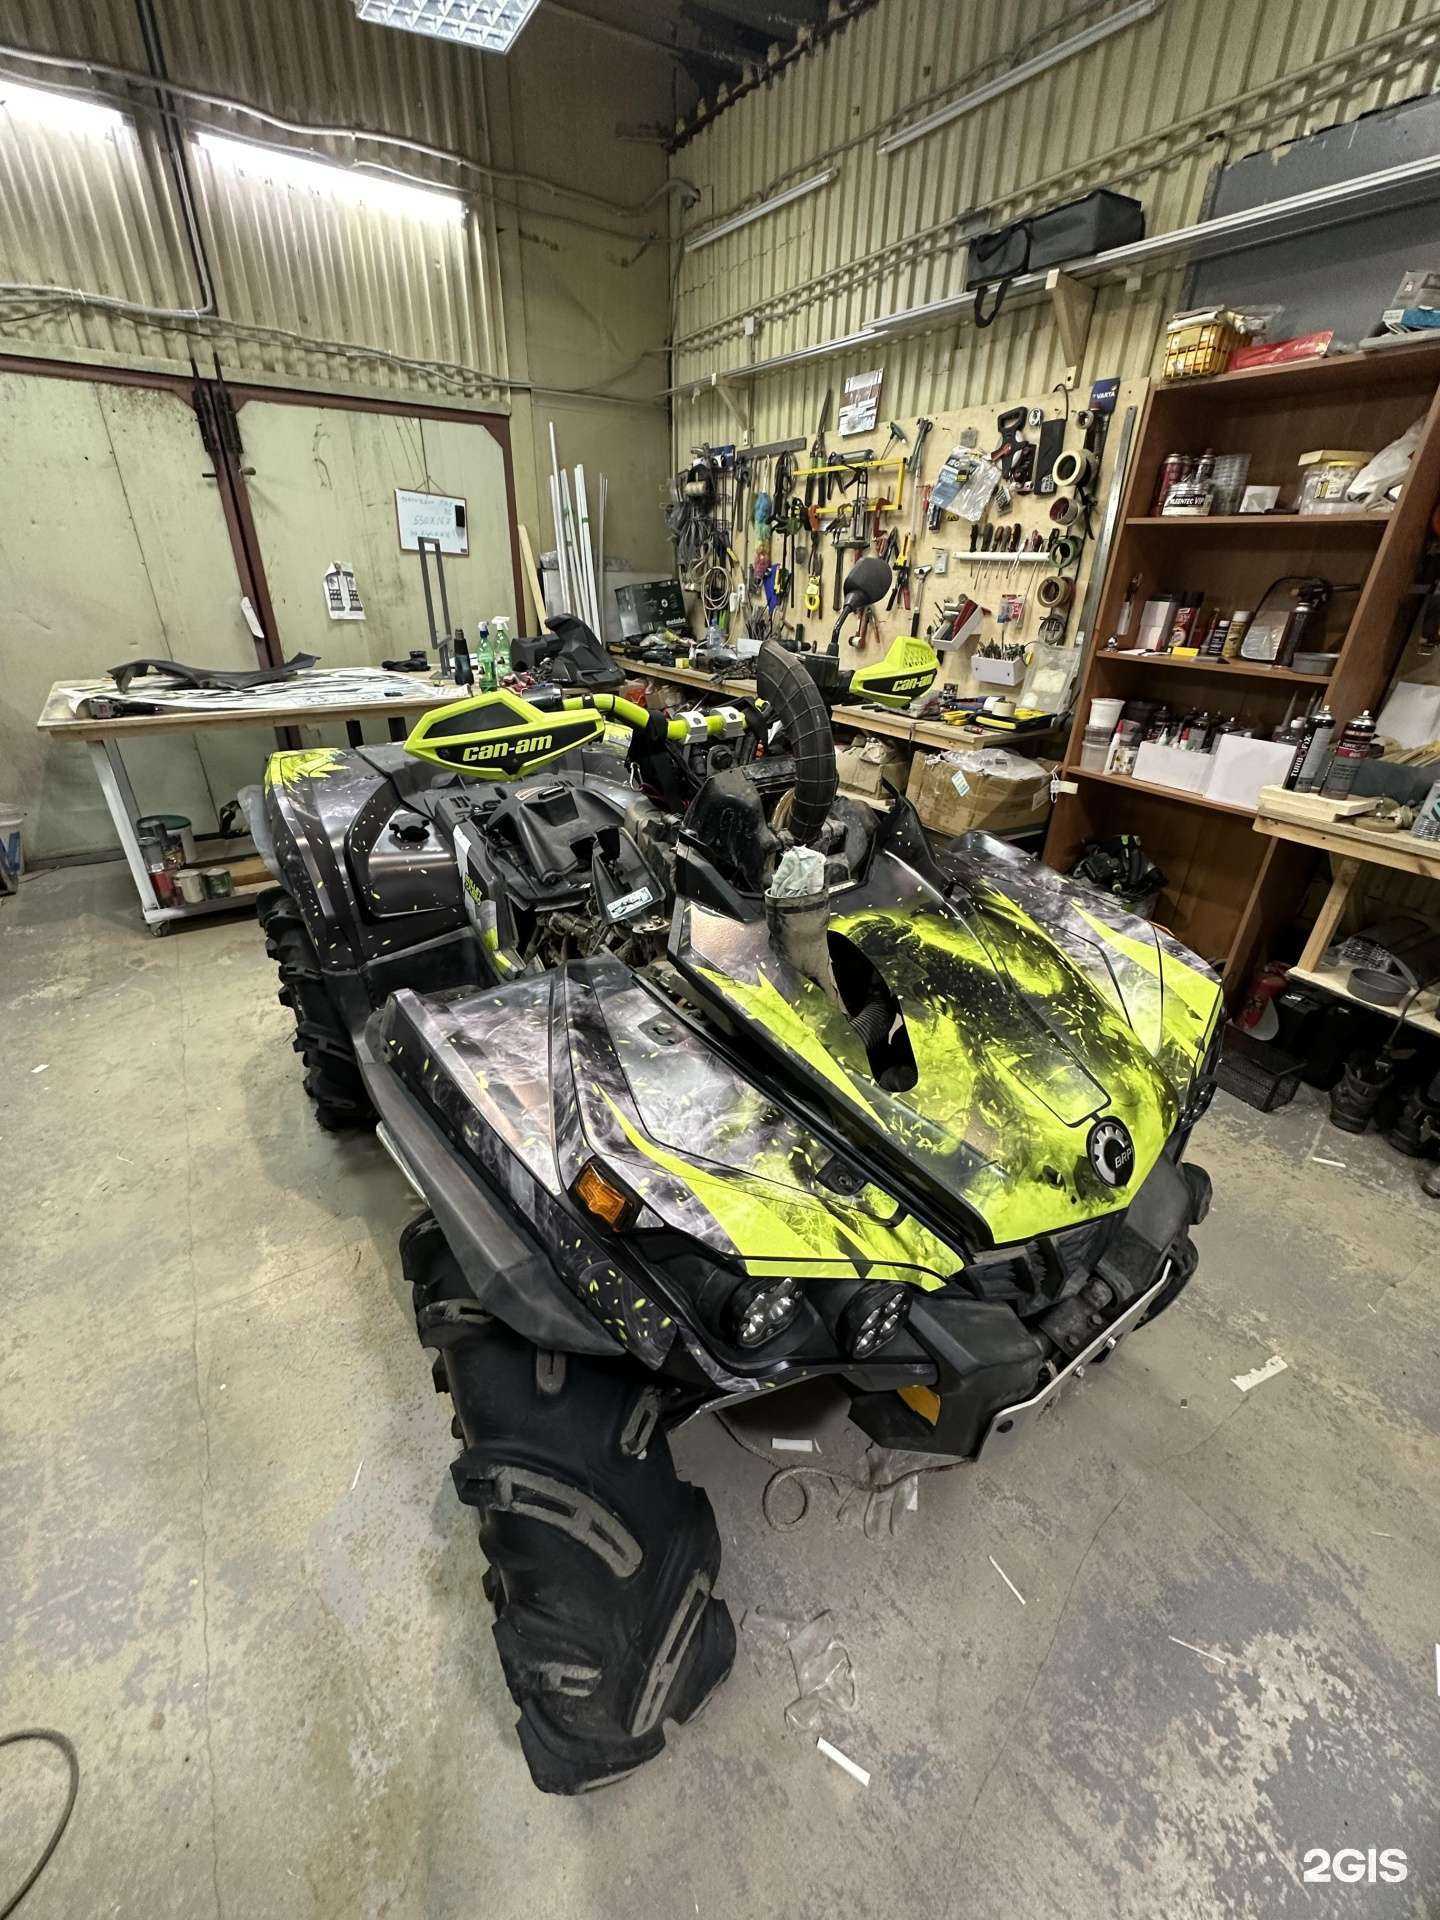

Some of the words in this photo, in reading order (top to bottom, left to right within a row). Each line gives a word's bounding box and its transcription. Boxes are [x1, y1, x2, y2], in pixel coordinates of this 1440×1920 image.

[1096, 391, 1115, 399] VARTA
[462, 734, 553, 762] can-am
[1115, 1149, 1132, 1168] BRP
